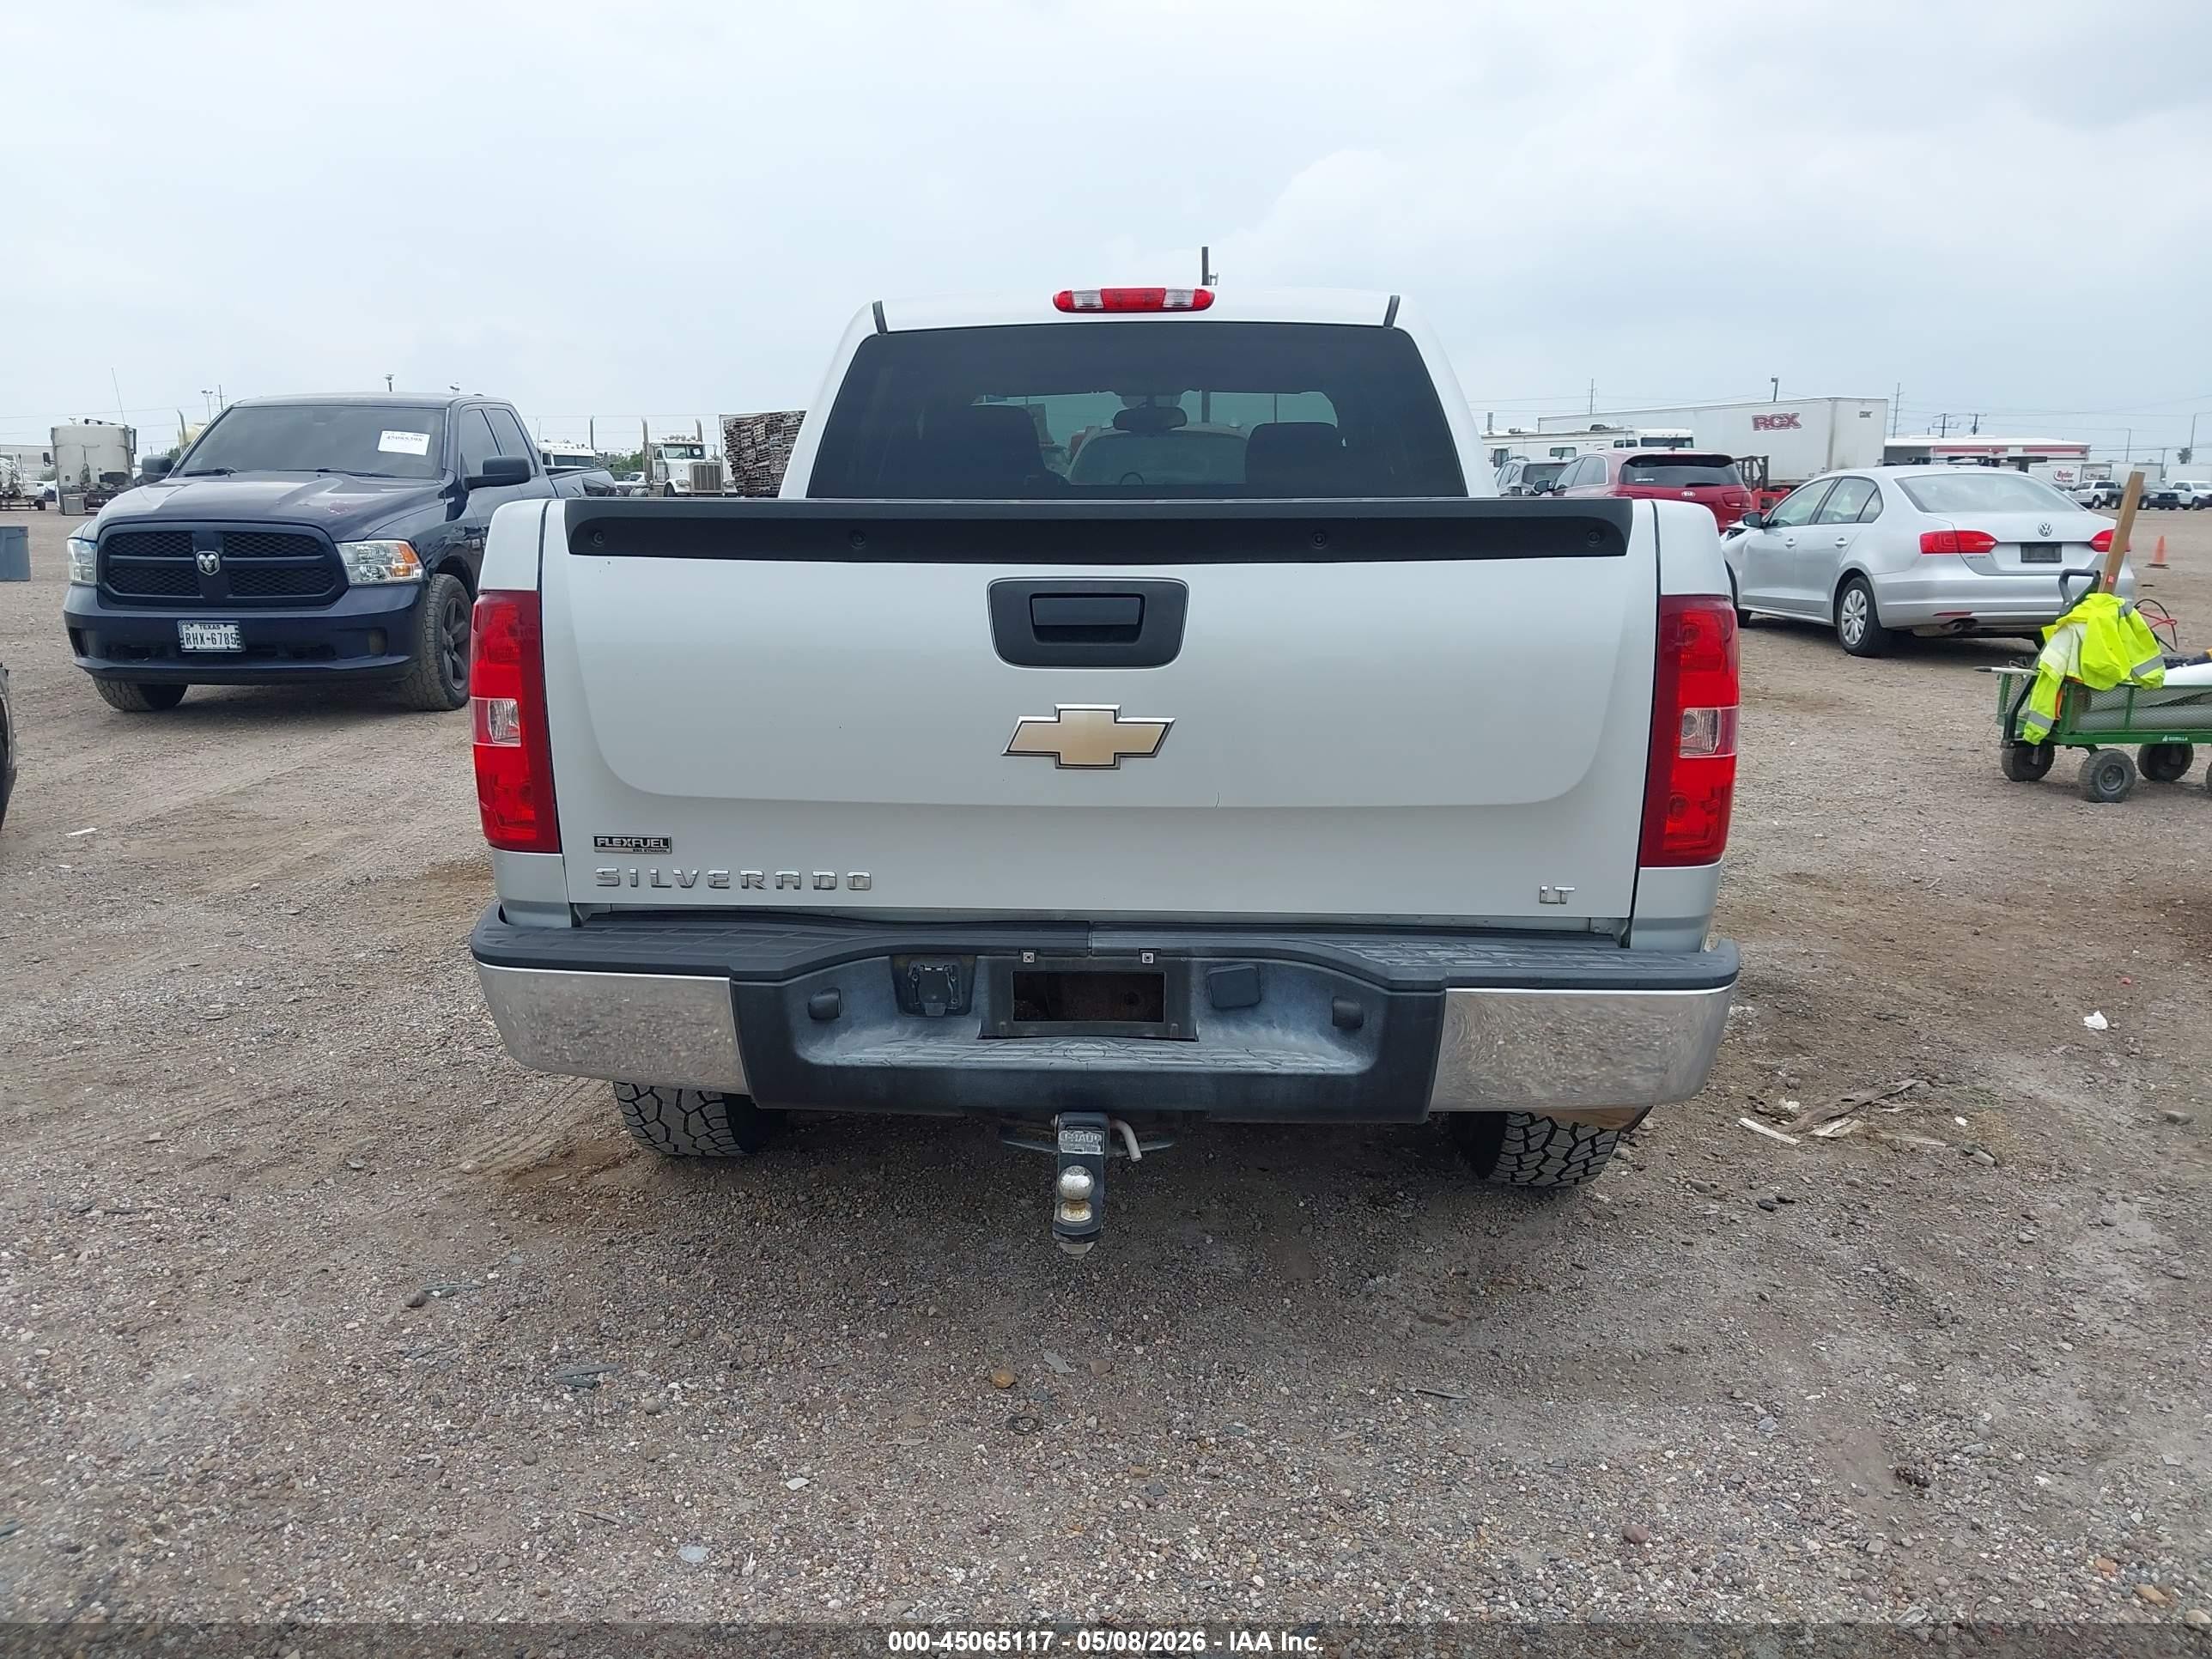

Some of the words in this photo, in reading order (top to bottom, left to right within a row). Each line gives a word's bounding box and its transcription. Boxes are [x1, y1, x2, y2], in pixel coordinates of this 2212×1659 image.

[185, 633, 237, 645] RHX-6785
[596, 837, 669, 848] FLEXFUEL
[595, 867, 872, 890] SILVERADO
[1539, 885, 1575, 904] LT
